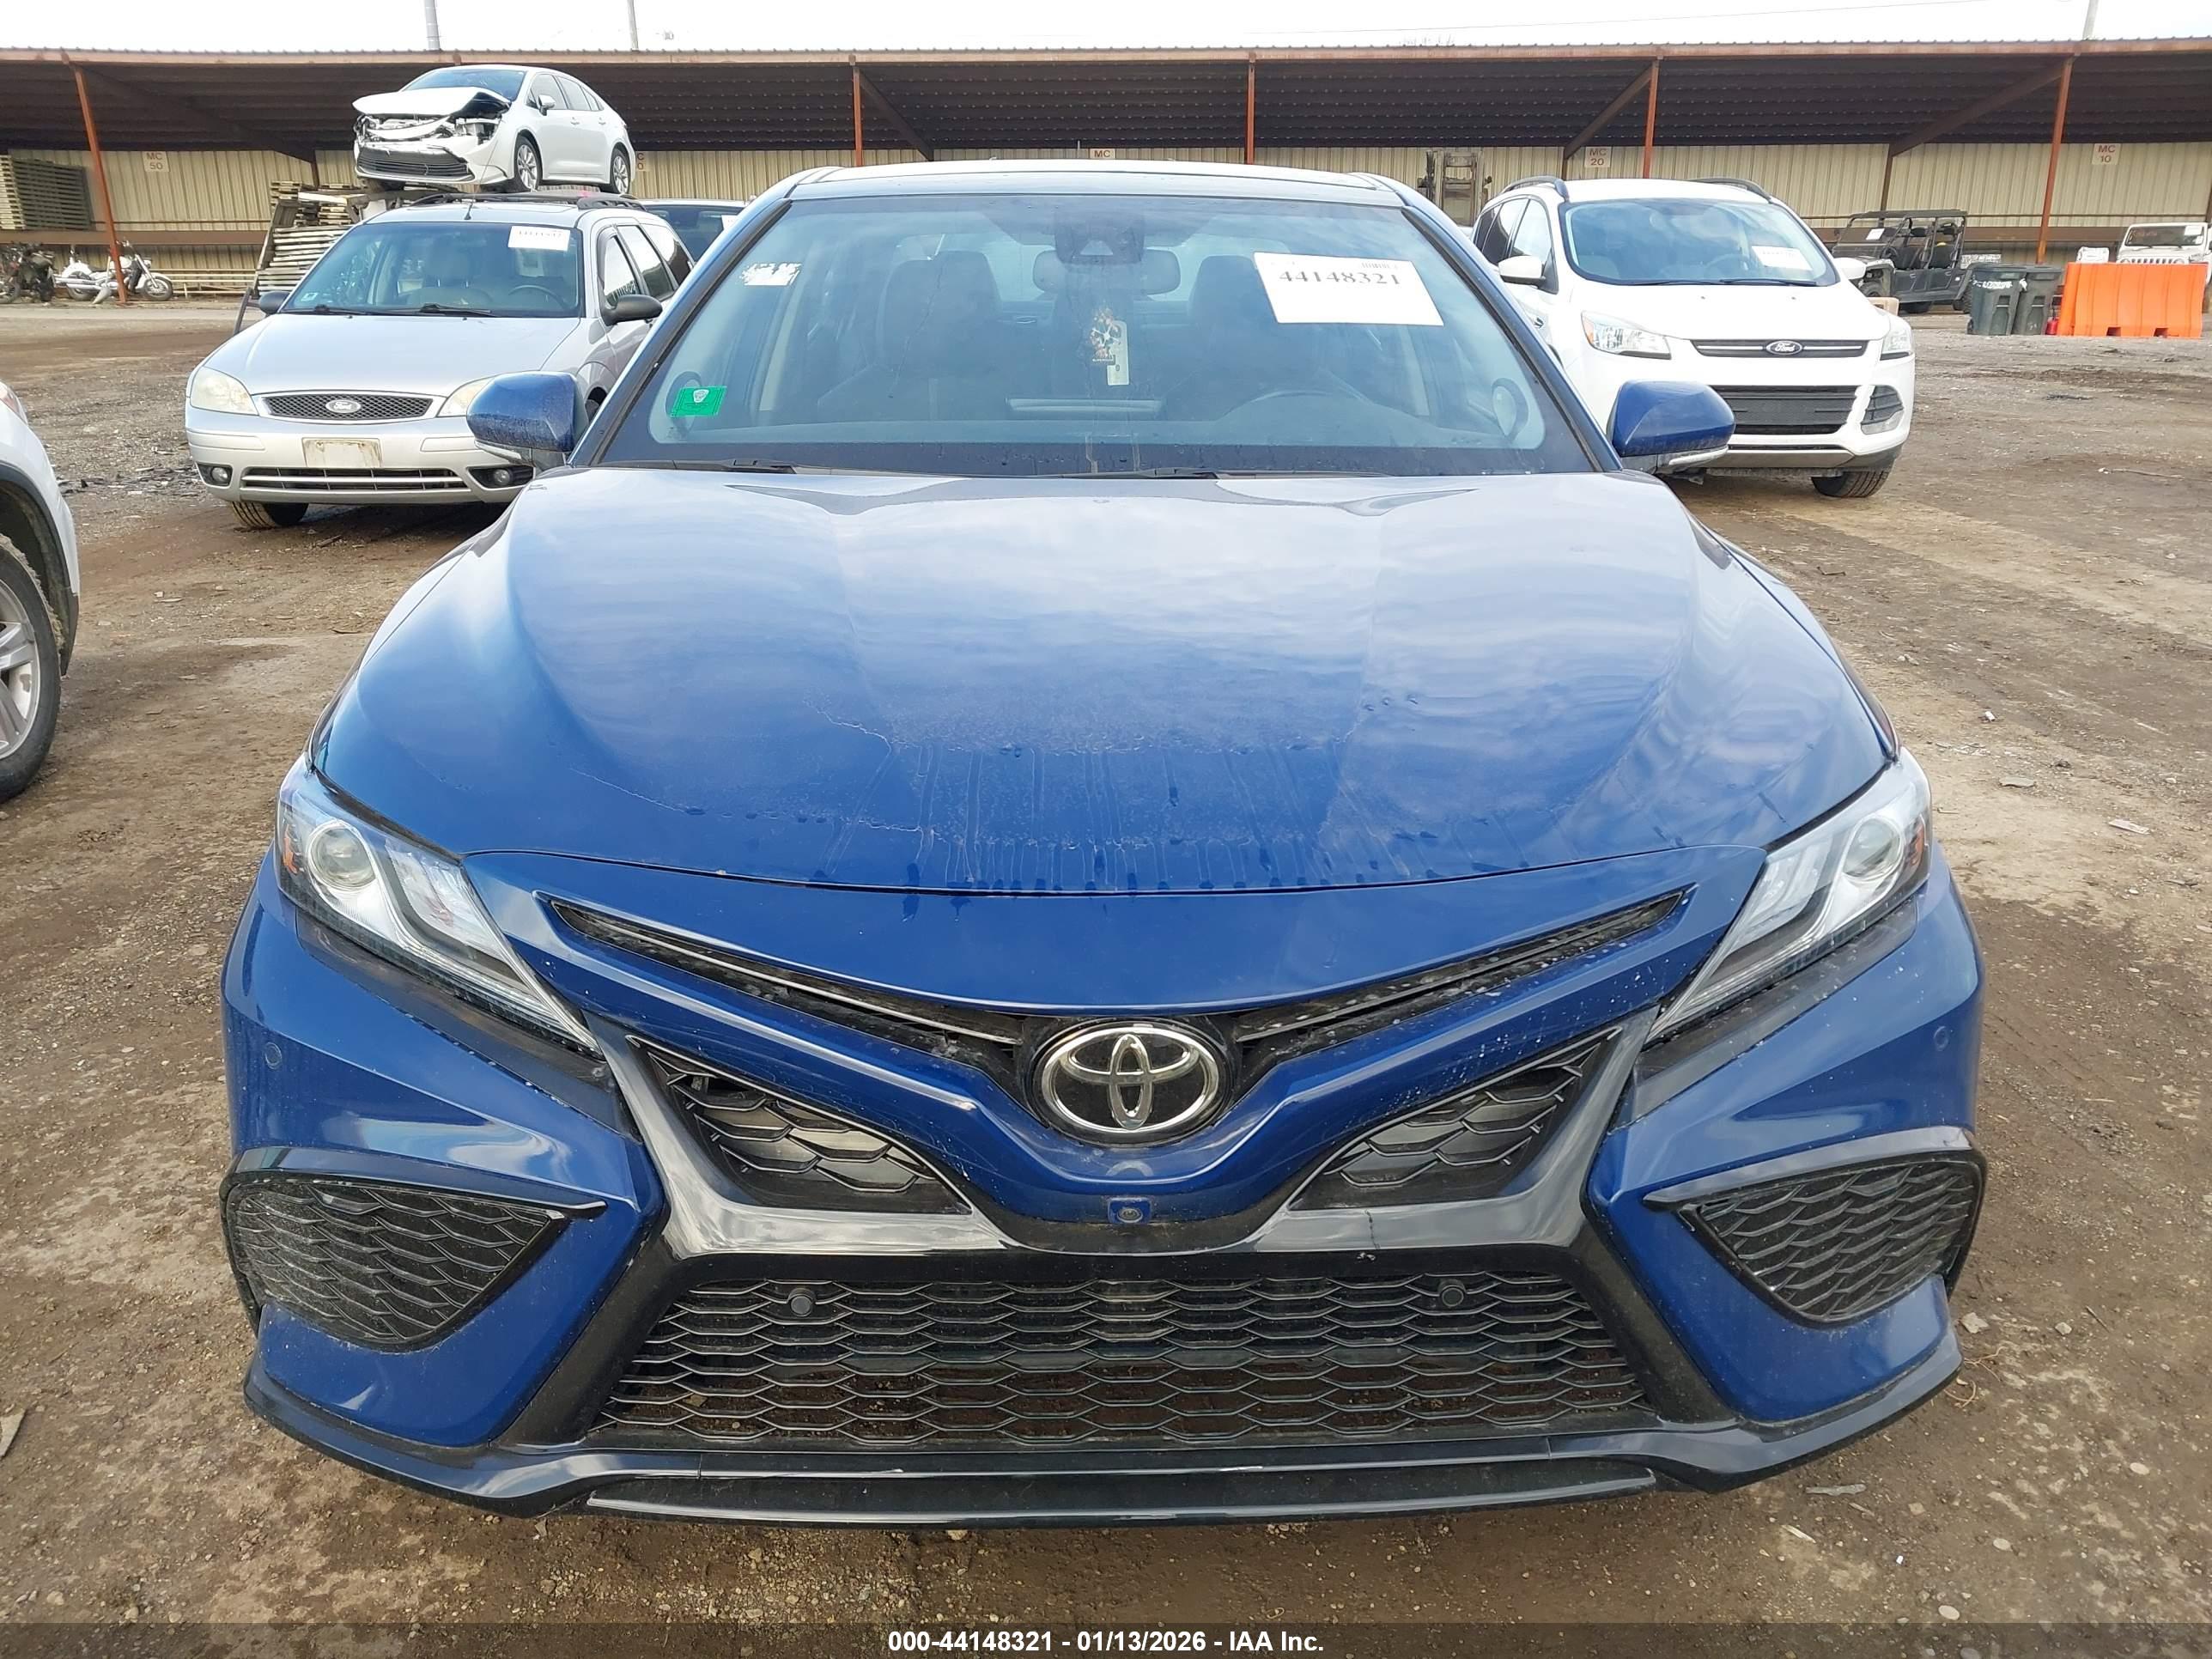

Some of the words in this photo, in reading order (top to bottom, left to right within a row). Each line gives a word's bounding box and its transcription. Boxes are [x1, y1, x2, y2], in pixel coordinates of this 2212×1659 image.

[1589, 148, 1607, 156] MC
[2098, 144, 2116, 153] MC
[146, 152, 163, 161] MC
[1094, 149, 1111, 158] MC
[2100, 155, 2112, 163] 10
[1279, 270, 1401, 285] 44148321
[1775, 343, 1796, 351] Ford
